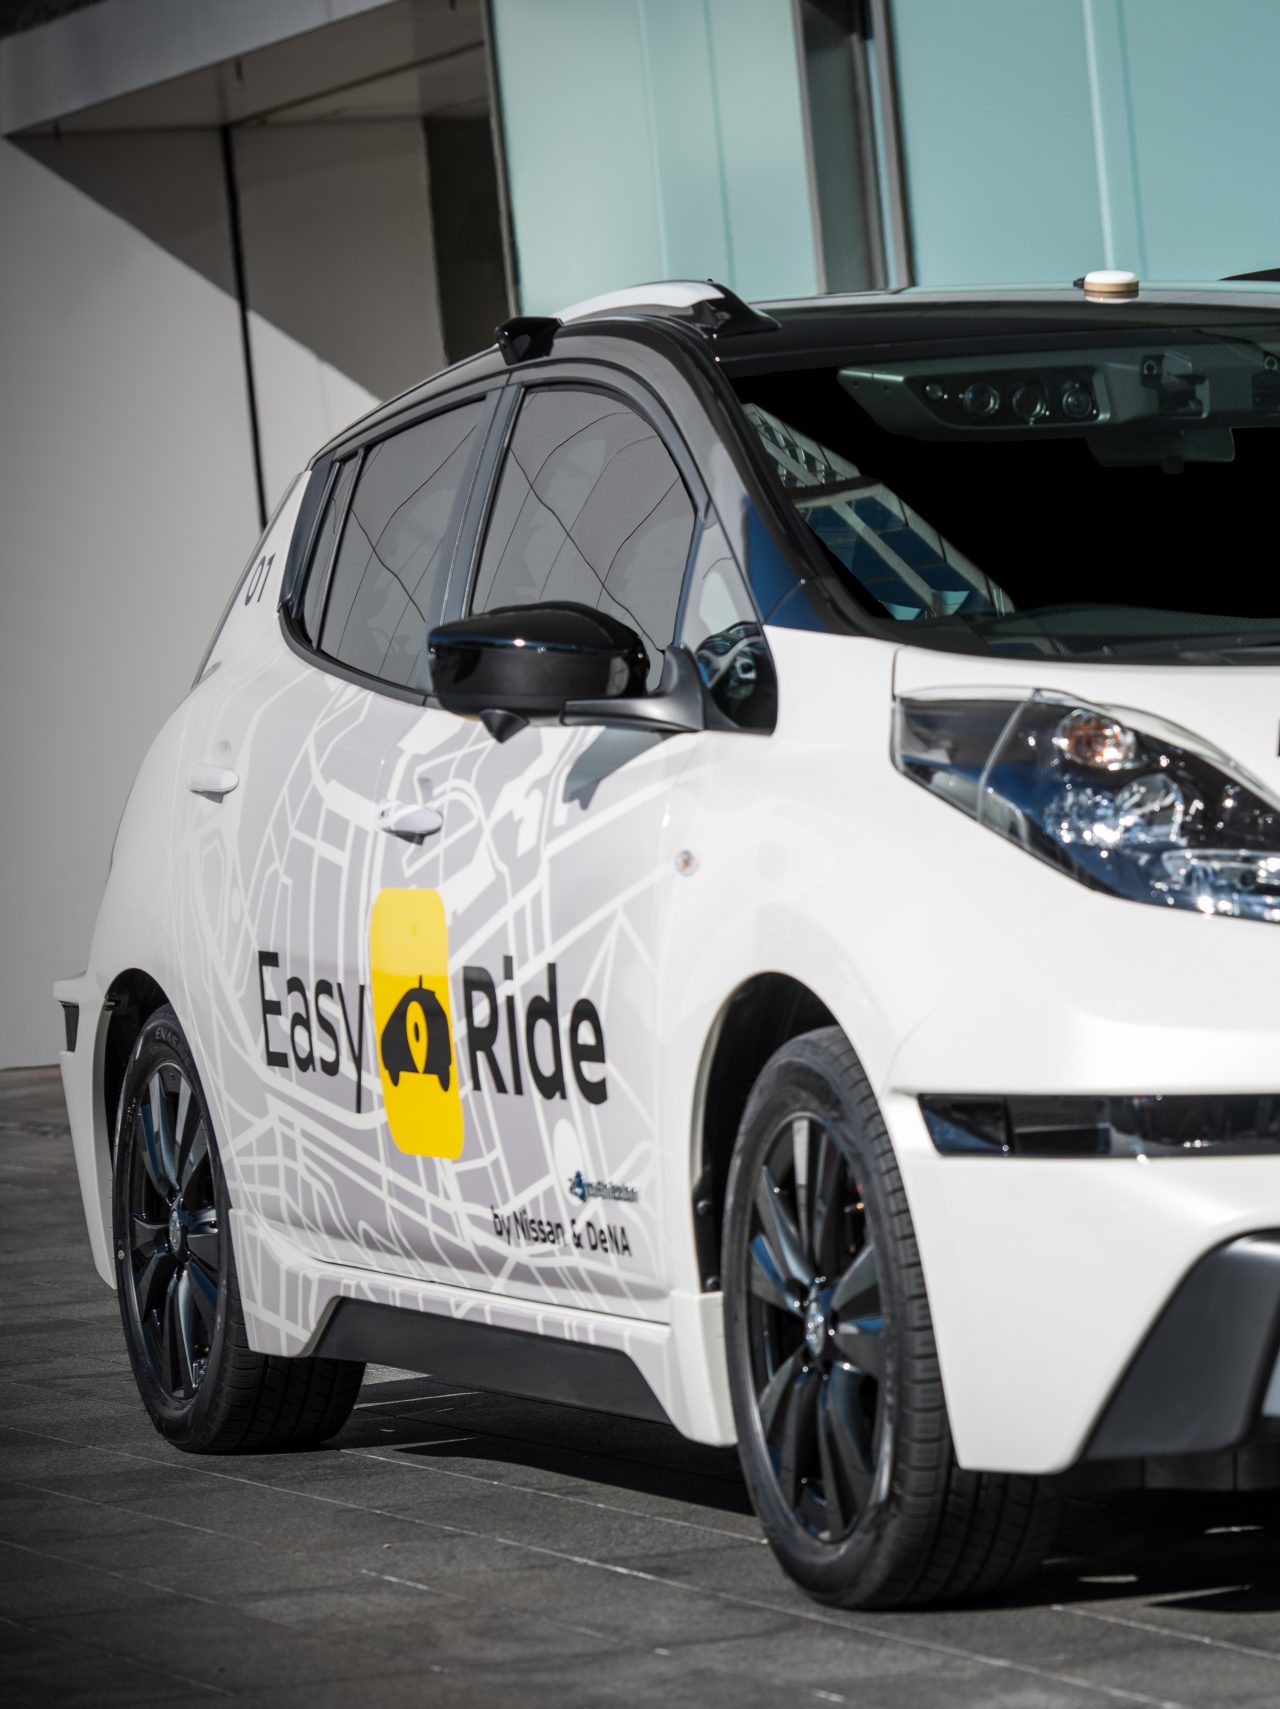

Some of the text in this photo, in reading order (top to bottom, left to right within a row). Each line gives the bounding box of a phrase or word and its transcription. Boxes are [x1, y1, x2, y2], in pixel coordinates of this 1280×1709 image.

[245, 552, 276, 606] 01
[258, 950, 608, 1114] Easy Ride
[491, 1205, 632, 1257] by Nissan & DeNA
